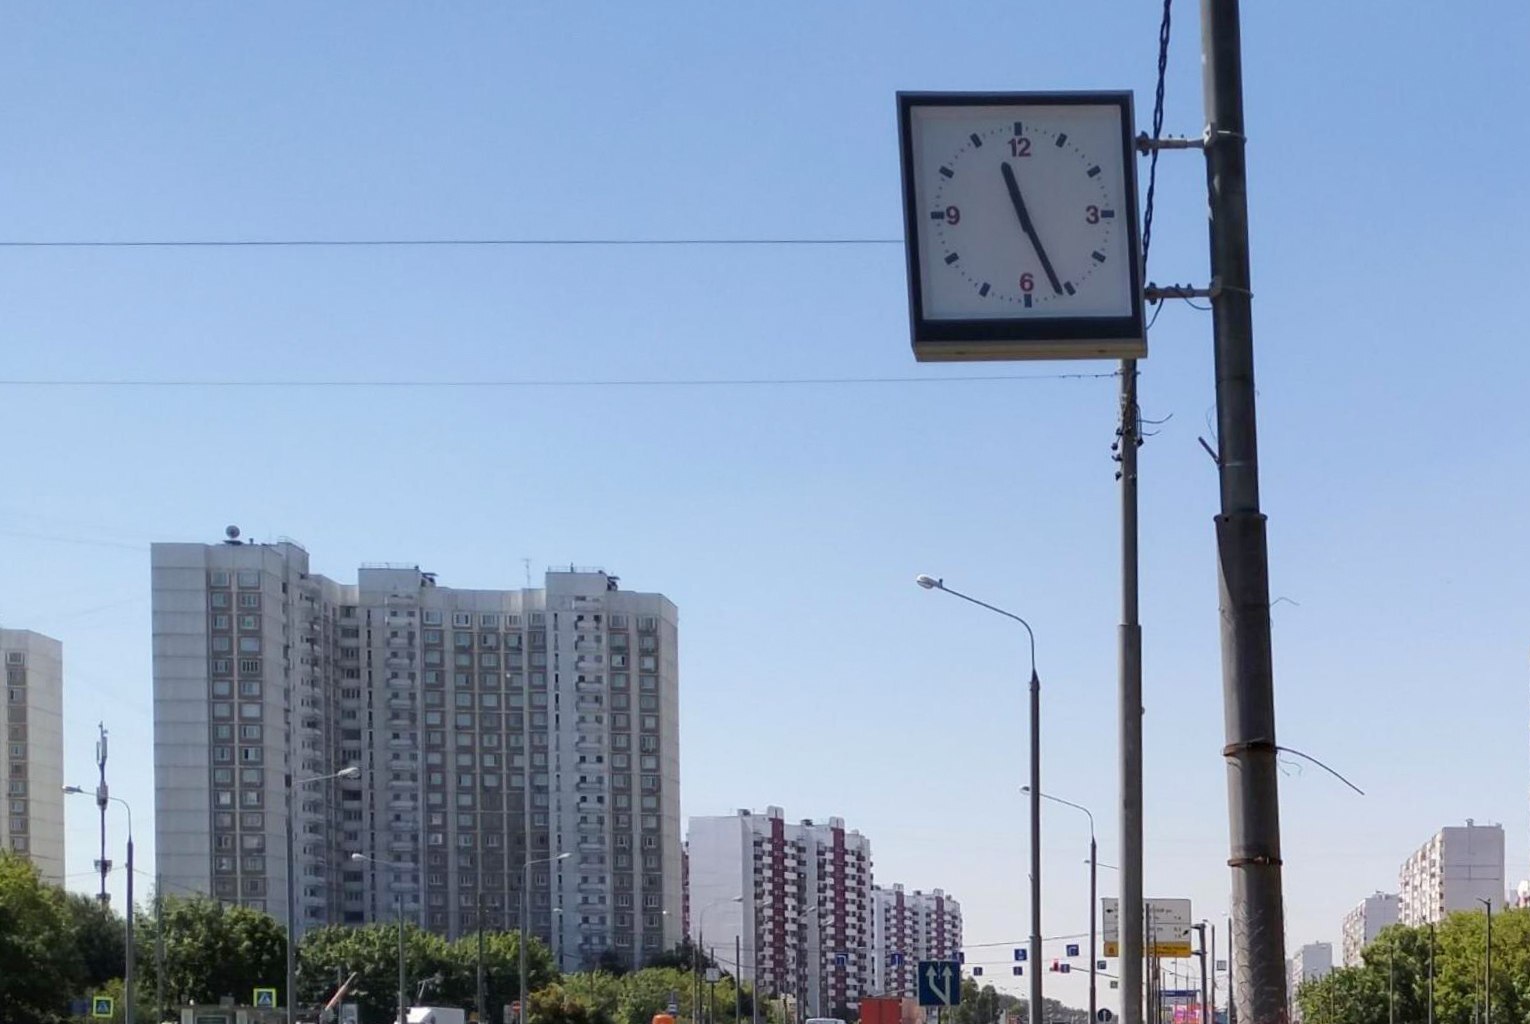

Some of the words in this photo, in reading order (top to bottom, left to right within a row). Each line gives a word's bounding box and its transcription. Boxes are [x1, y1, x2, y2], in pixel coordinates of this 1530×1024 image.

[1008, 138, 1031, 157] 12
[945, 206, 960, 225] 9
[1085, 205, 1100, 224] 3
[1019, 273, 1034, 292] 6
